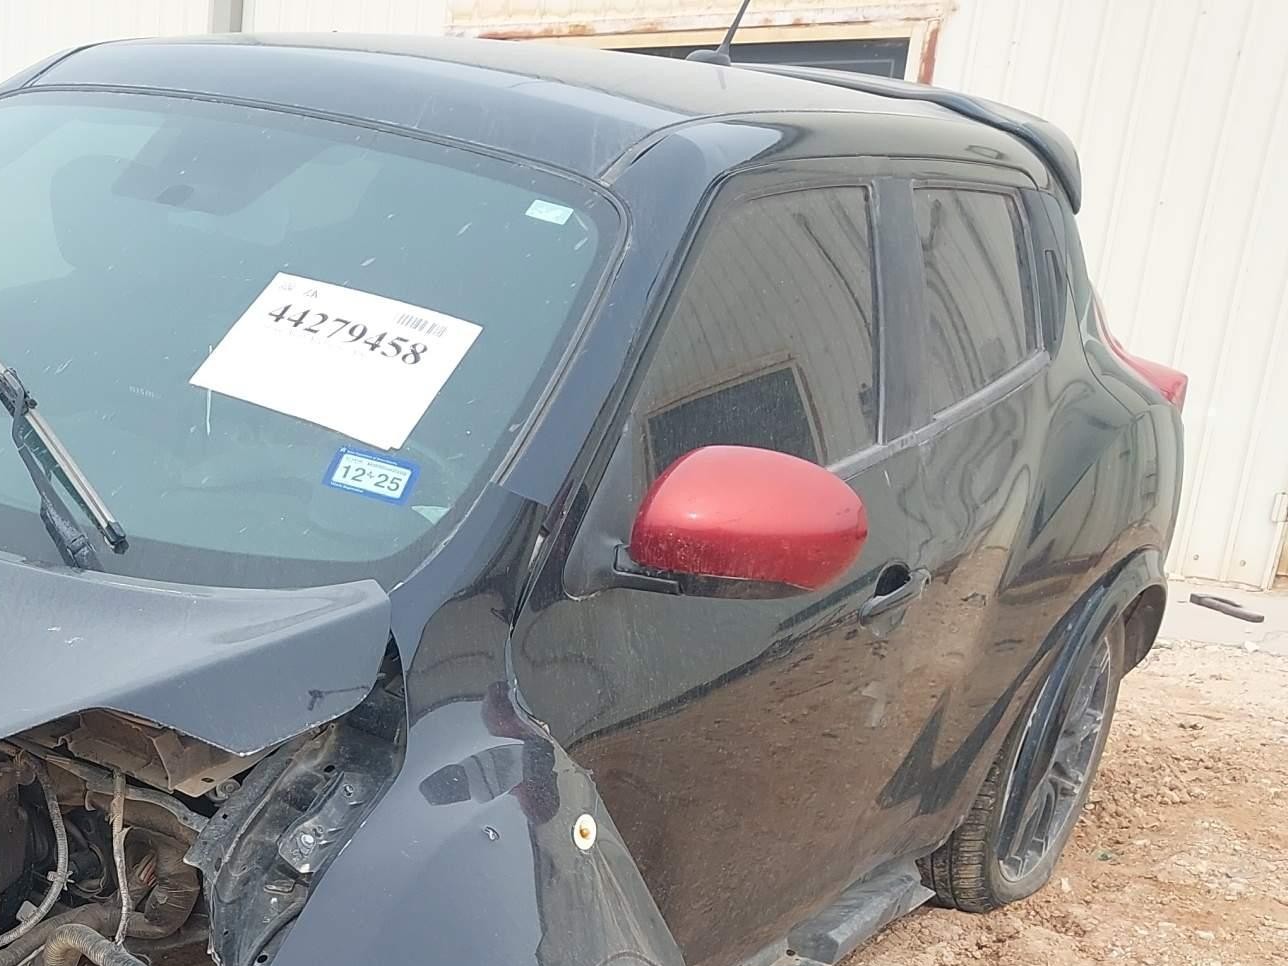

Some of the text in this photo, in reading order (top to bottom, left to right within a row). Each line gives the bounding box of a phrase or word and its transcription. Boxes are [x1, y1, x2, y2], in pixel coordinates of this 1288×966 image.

[268, 303, 428, 365] 44279458
[342, 464, 366, 482] 12
[374, 473, 402, 492] 25
